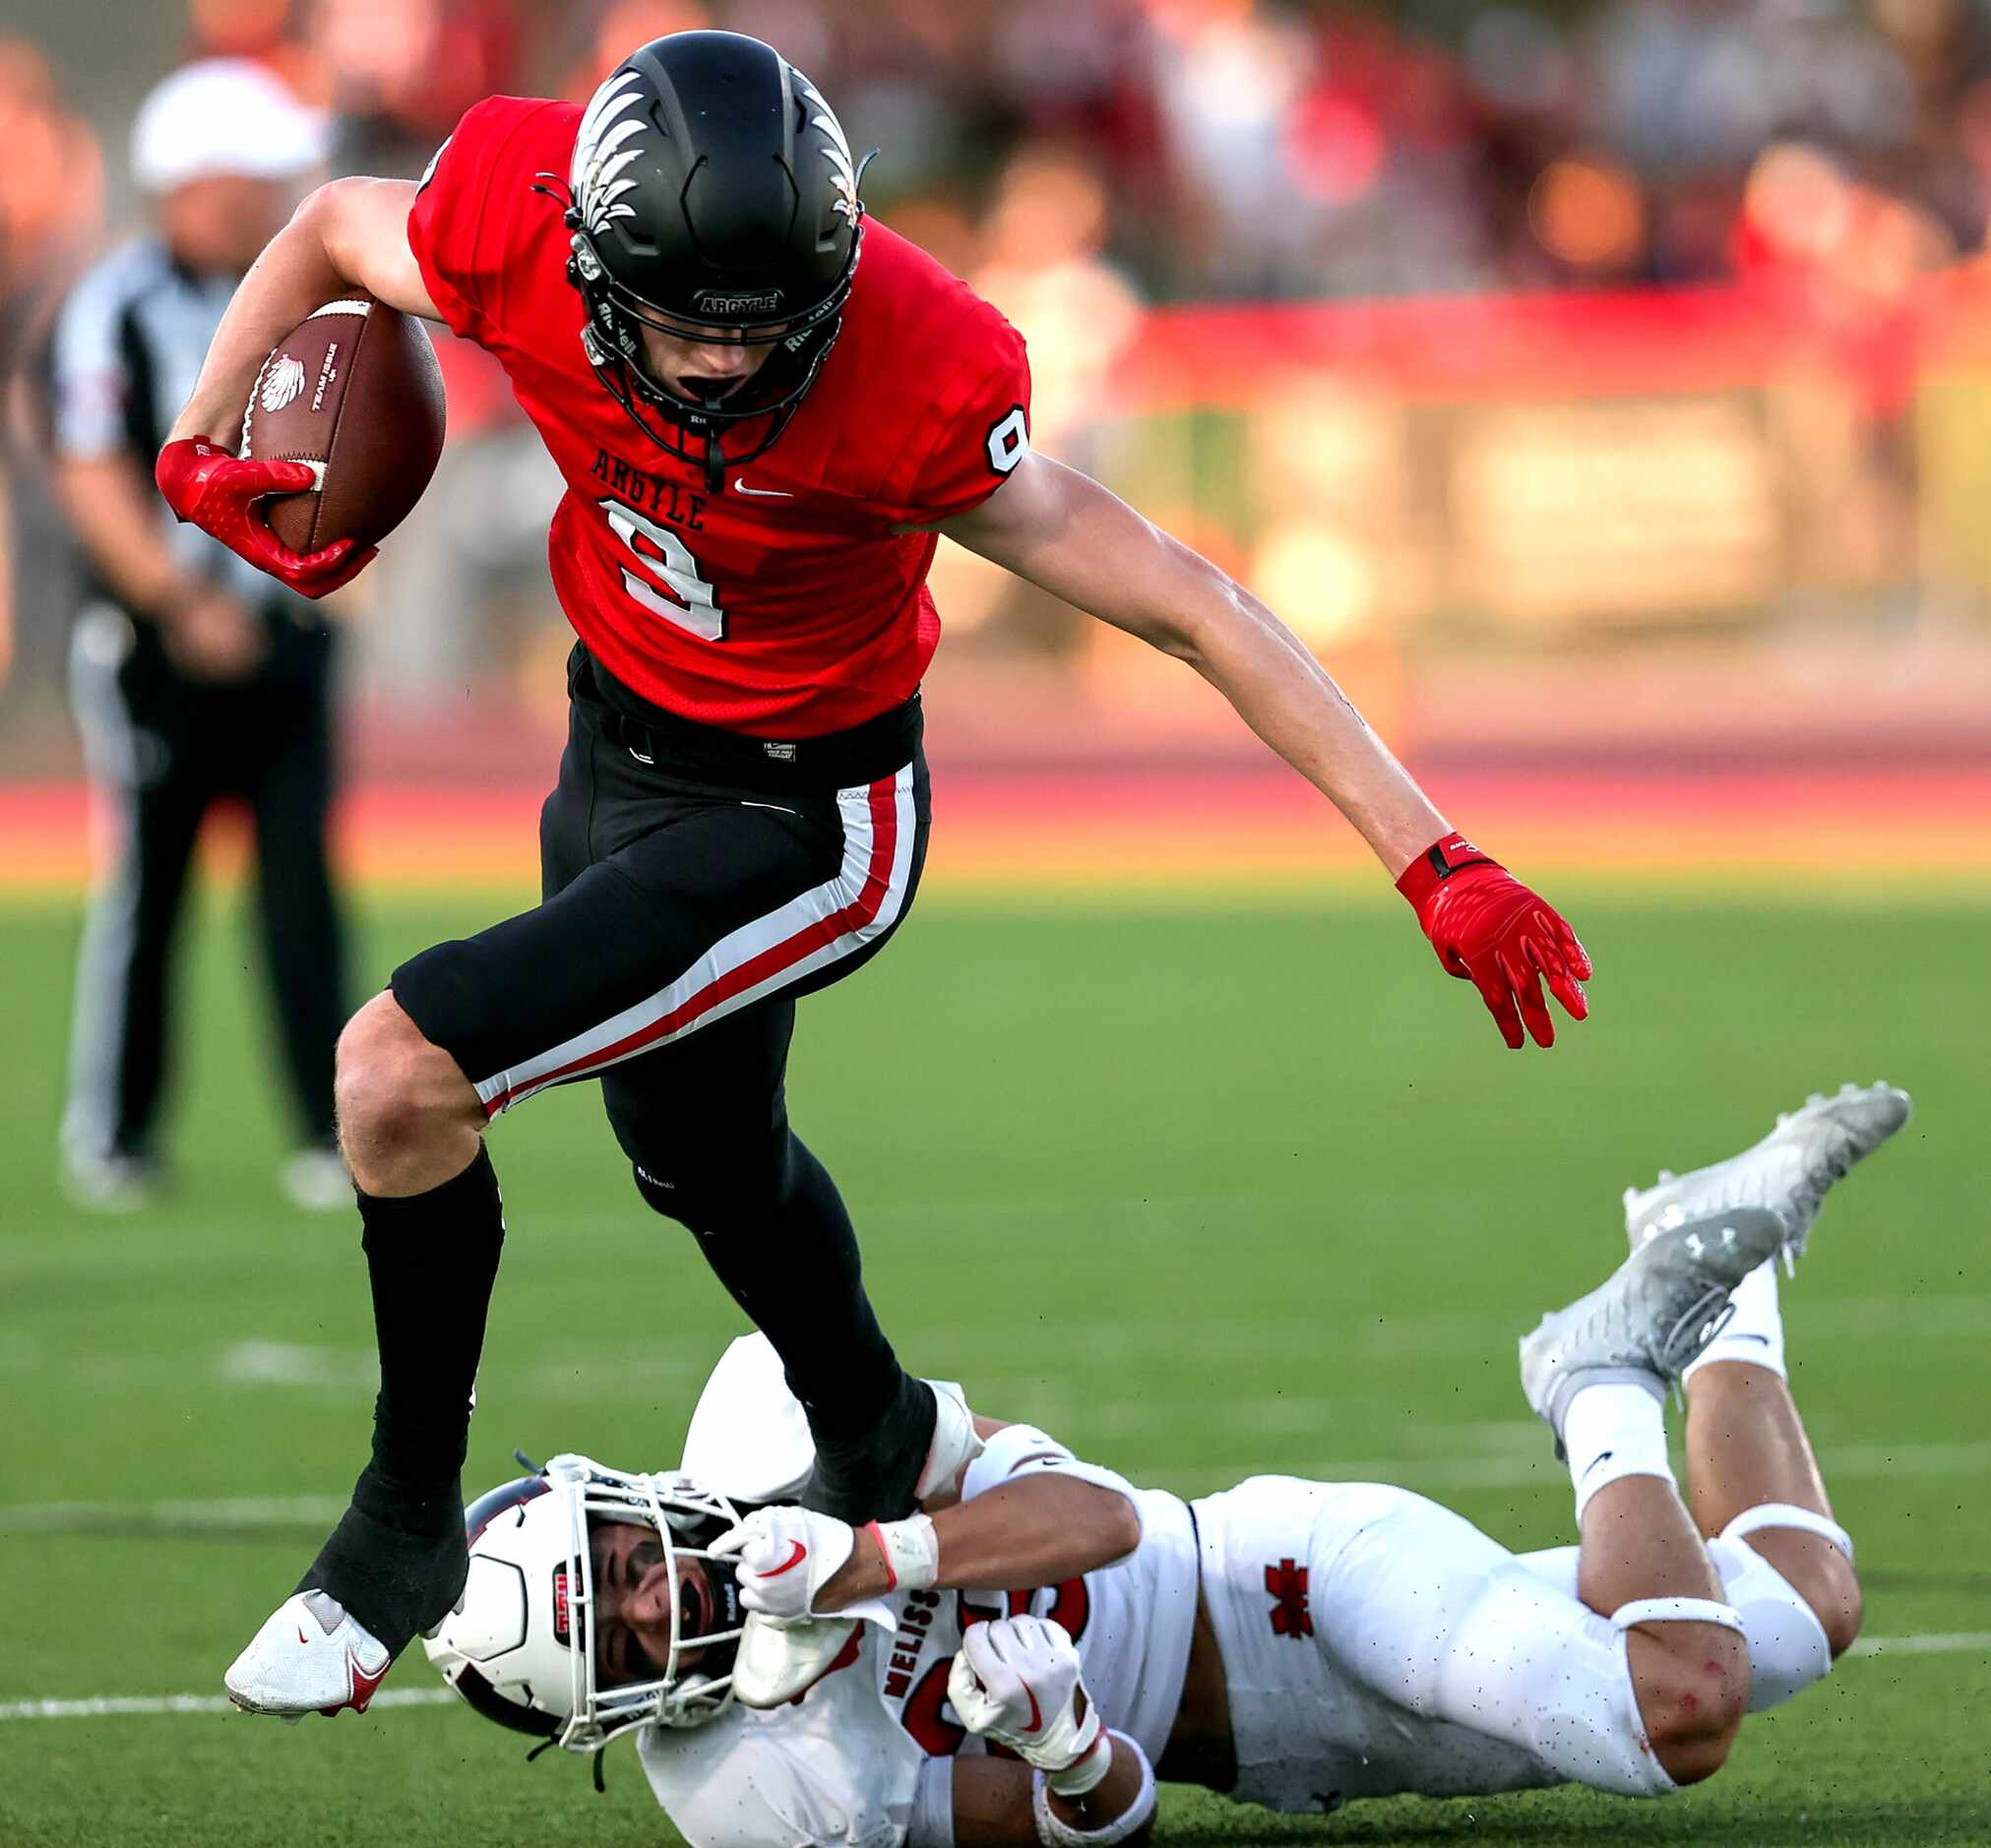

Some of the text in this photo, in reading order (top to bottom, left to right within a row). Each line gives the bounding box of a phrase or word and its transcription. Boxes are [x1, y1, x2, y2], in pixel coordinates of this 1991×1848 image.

[700, 294, 778, 314] ARGYLE
[311, 375, 327, 411] TEAM
[591, 449, 708, 531] ARGYLE
[884, 1587, 941, 1699] MELISS
